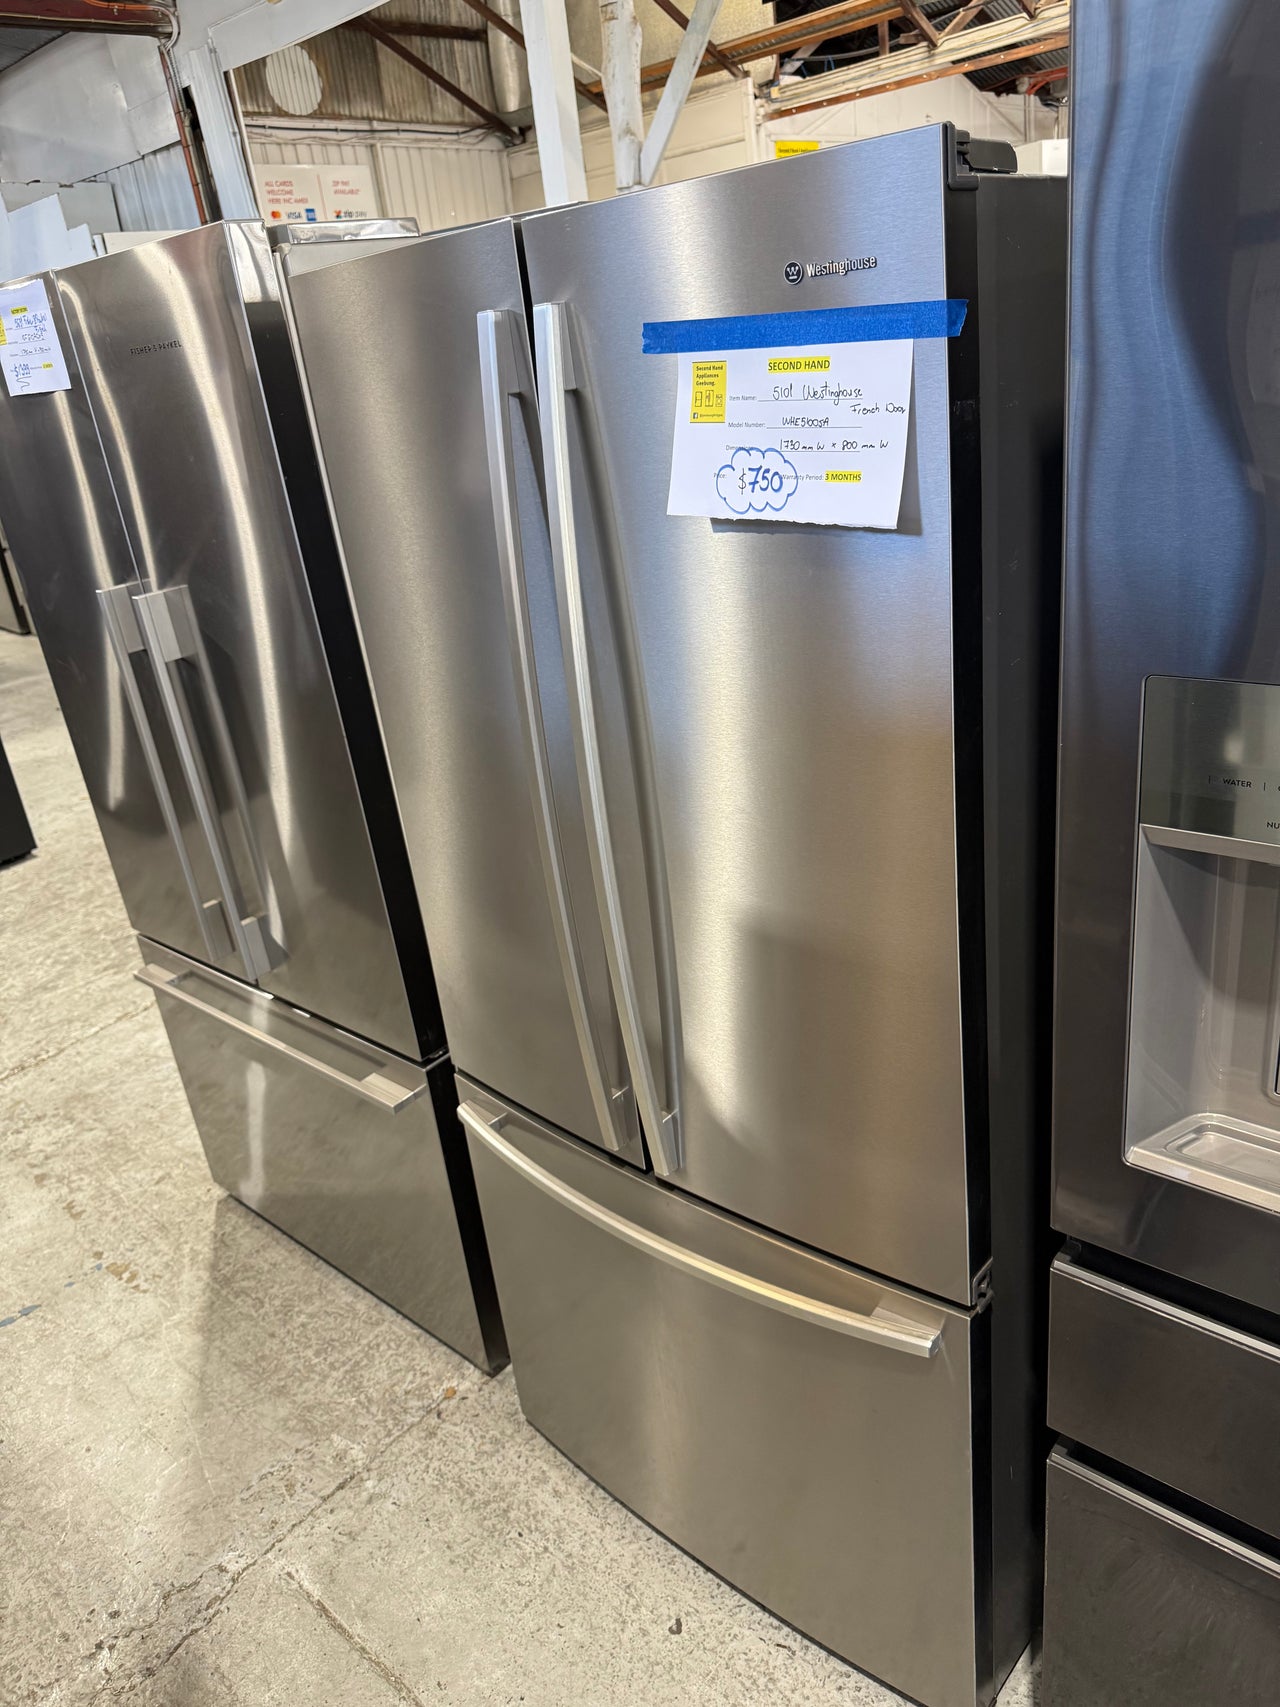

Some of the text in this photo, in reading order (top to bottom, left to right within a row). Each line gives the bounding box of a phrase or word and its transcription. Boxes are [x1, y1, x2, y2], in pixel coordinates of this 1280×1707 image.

[806, 256, 877, 277] Westinghouse
[768, 359, 830, 371] SECOND HAND
[803, 381, 862, 405] Westinghouse
[850, 403, 880, 415] French
[780, 439, 800, 451] 1730
[842, 440, 858, 451] 800
[738, 465, 784, 495] $750
[830, 473, 862, 481] MONTHS
[1223, 778, 1252, 788] WATER
